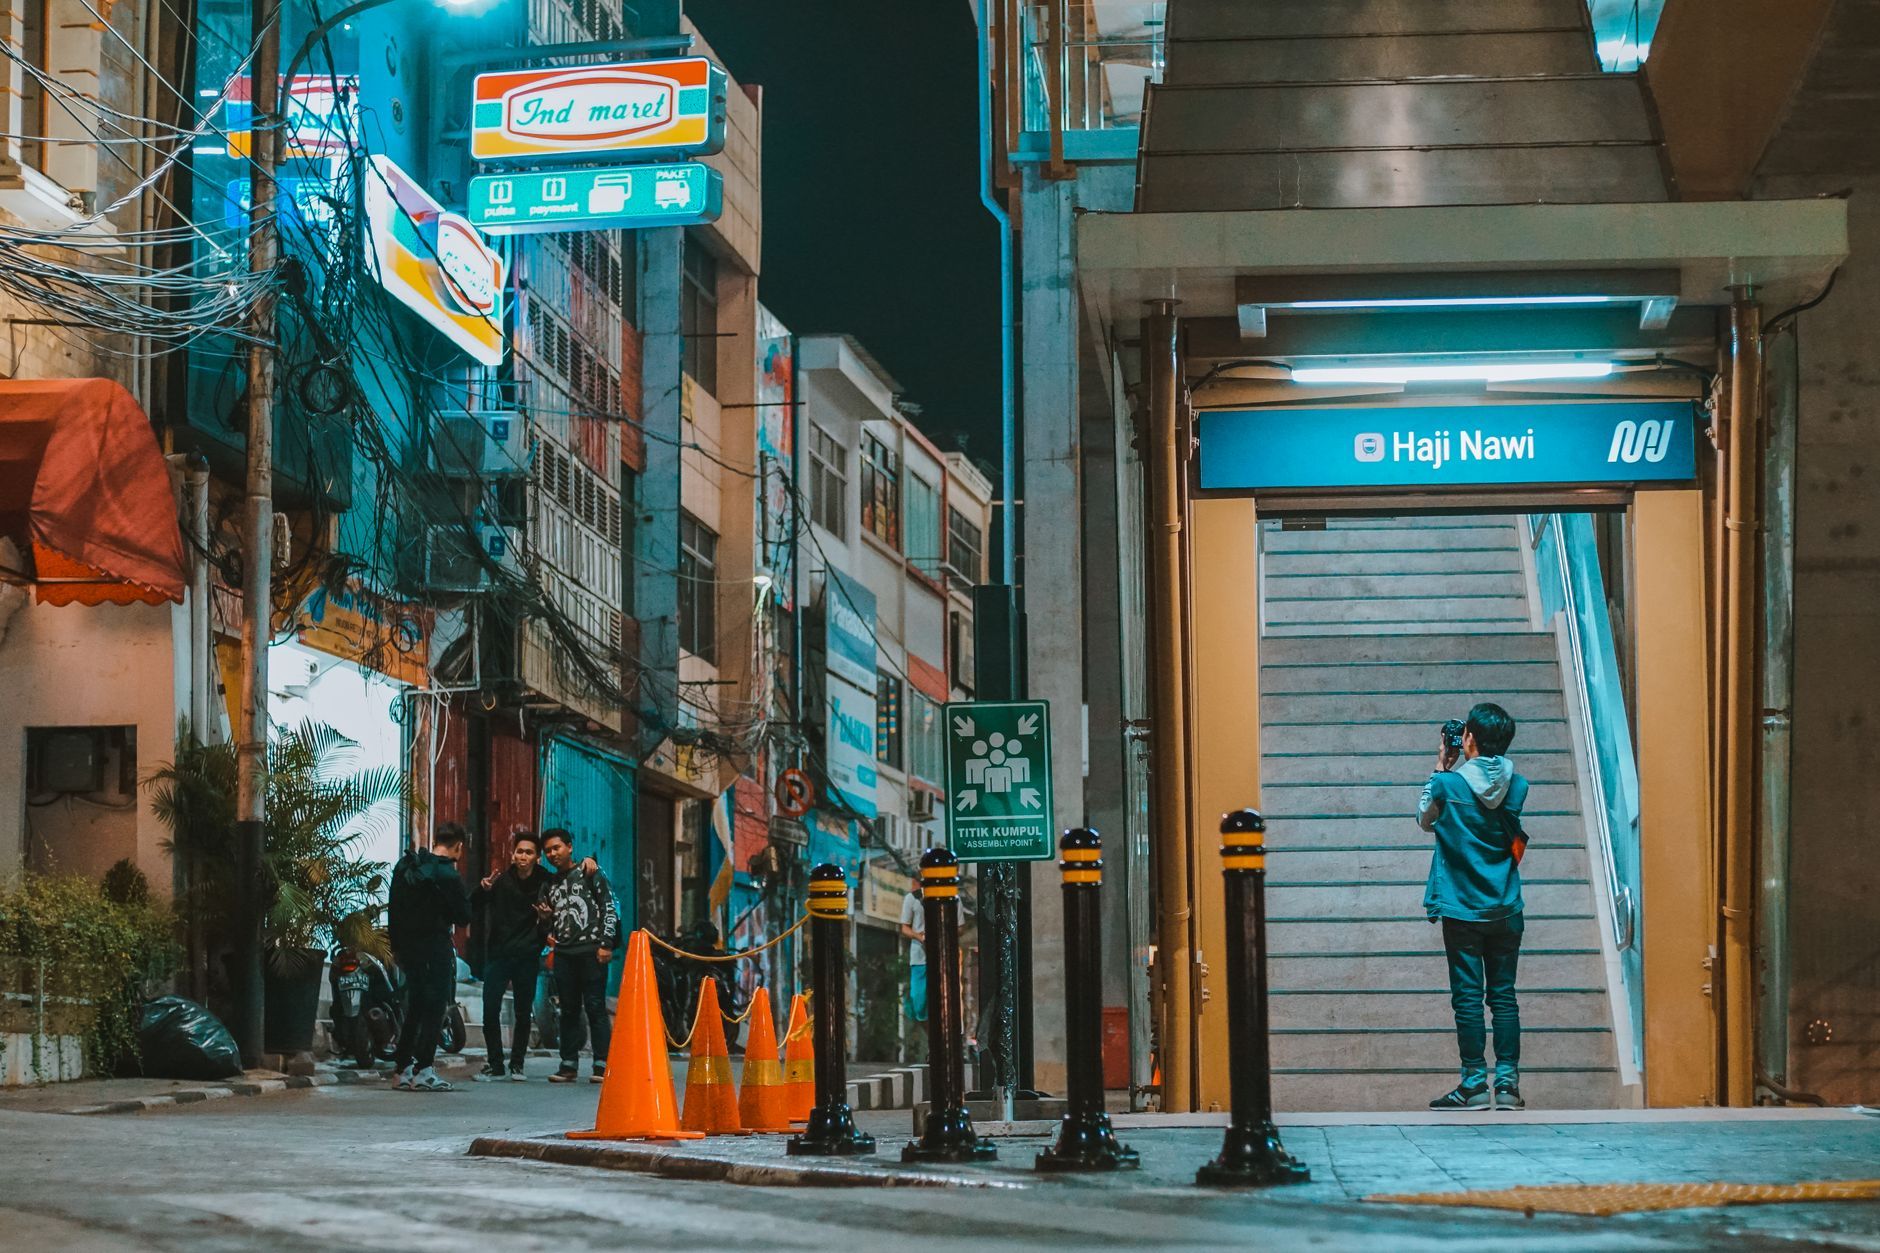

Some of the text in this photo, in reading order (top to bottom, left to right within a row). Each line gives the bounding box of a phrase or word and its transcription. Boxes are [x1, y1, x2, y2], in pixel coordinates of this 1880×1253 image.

[656, 168, 693, 180] PAKET
[529, 202, 579, 217] payment
[1392, 429, 1535, 470] Haji Nawi
[957, 826, 1043, 838] TITIK KUMPUL
[966, 838, 1034, 848] ASSEMBLY POINT
